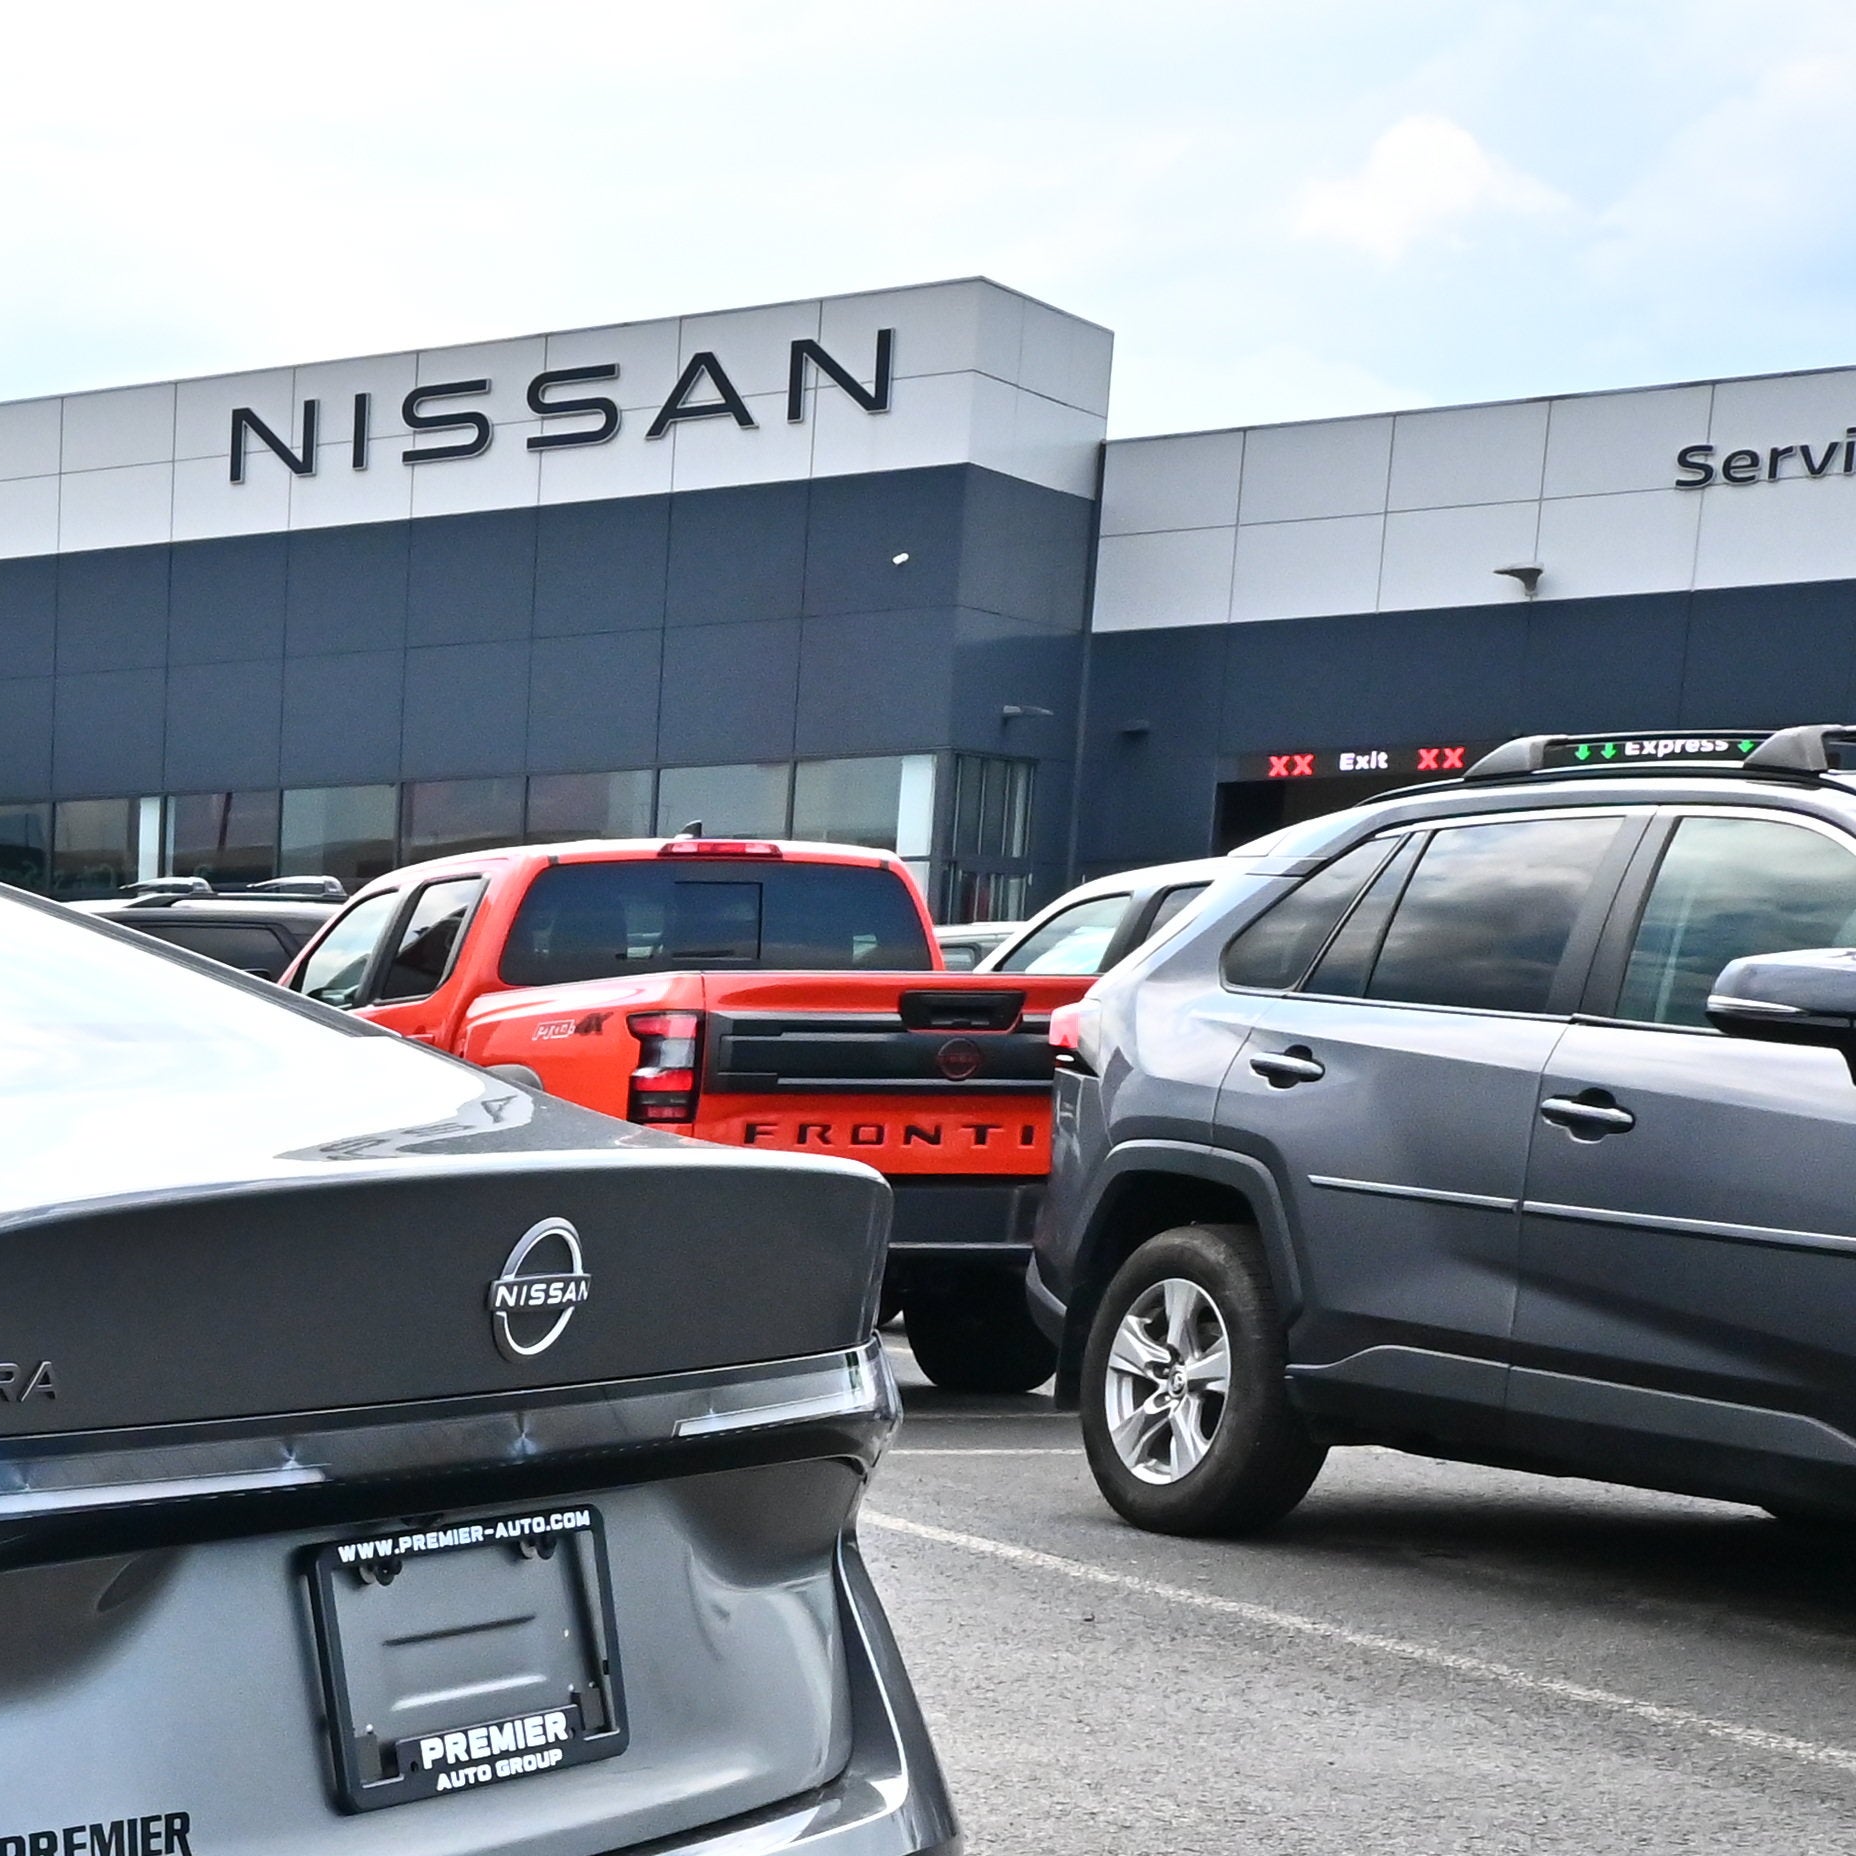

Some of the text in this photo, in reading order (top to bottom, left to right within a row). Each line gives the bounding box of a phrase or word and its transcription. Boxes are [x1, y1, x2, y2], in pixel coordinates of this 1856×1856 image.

[228, 327, 895, 484] NISSAN
[1675, 427, 1856, 490] Servi
[1339, 751, 1388, 771] Exit
[1624, 740, 1729, 757] Express
[743, 1123, 1038, 1148] FRONTI
[494, 1280, 589, 1307] NISSAN
[338, 1510, 591, 1563] WWW.PREMIER-AUTO.COM
[420, 1711, 568, 1770] PREMIER
[437, 1748, 563, 1791] AUTO GROUP
